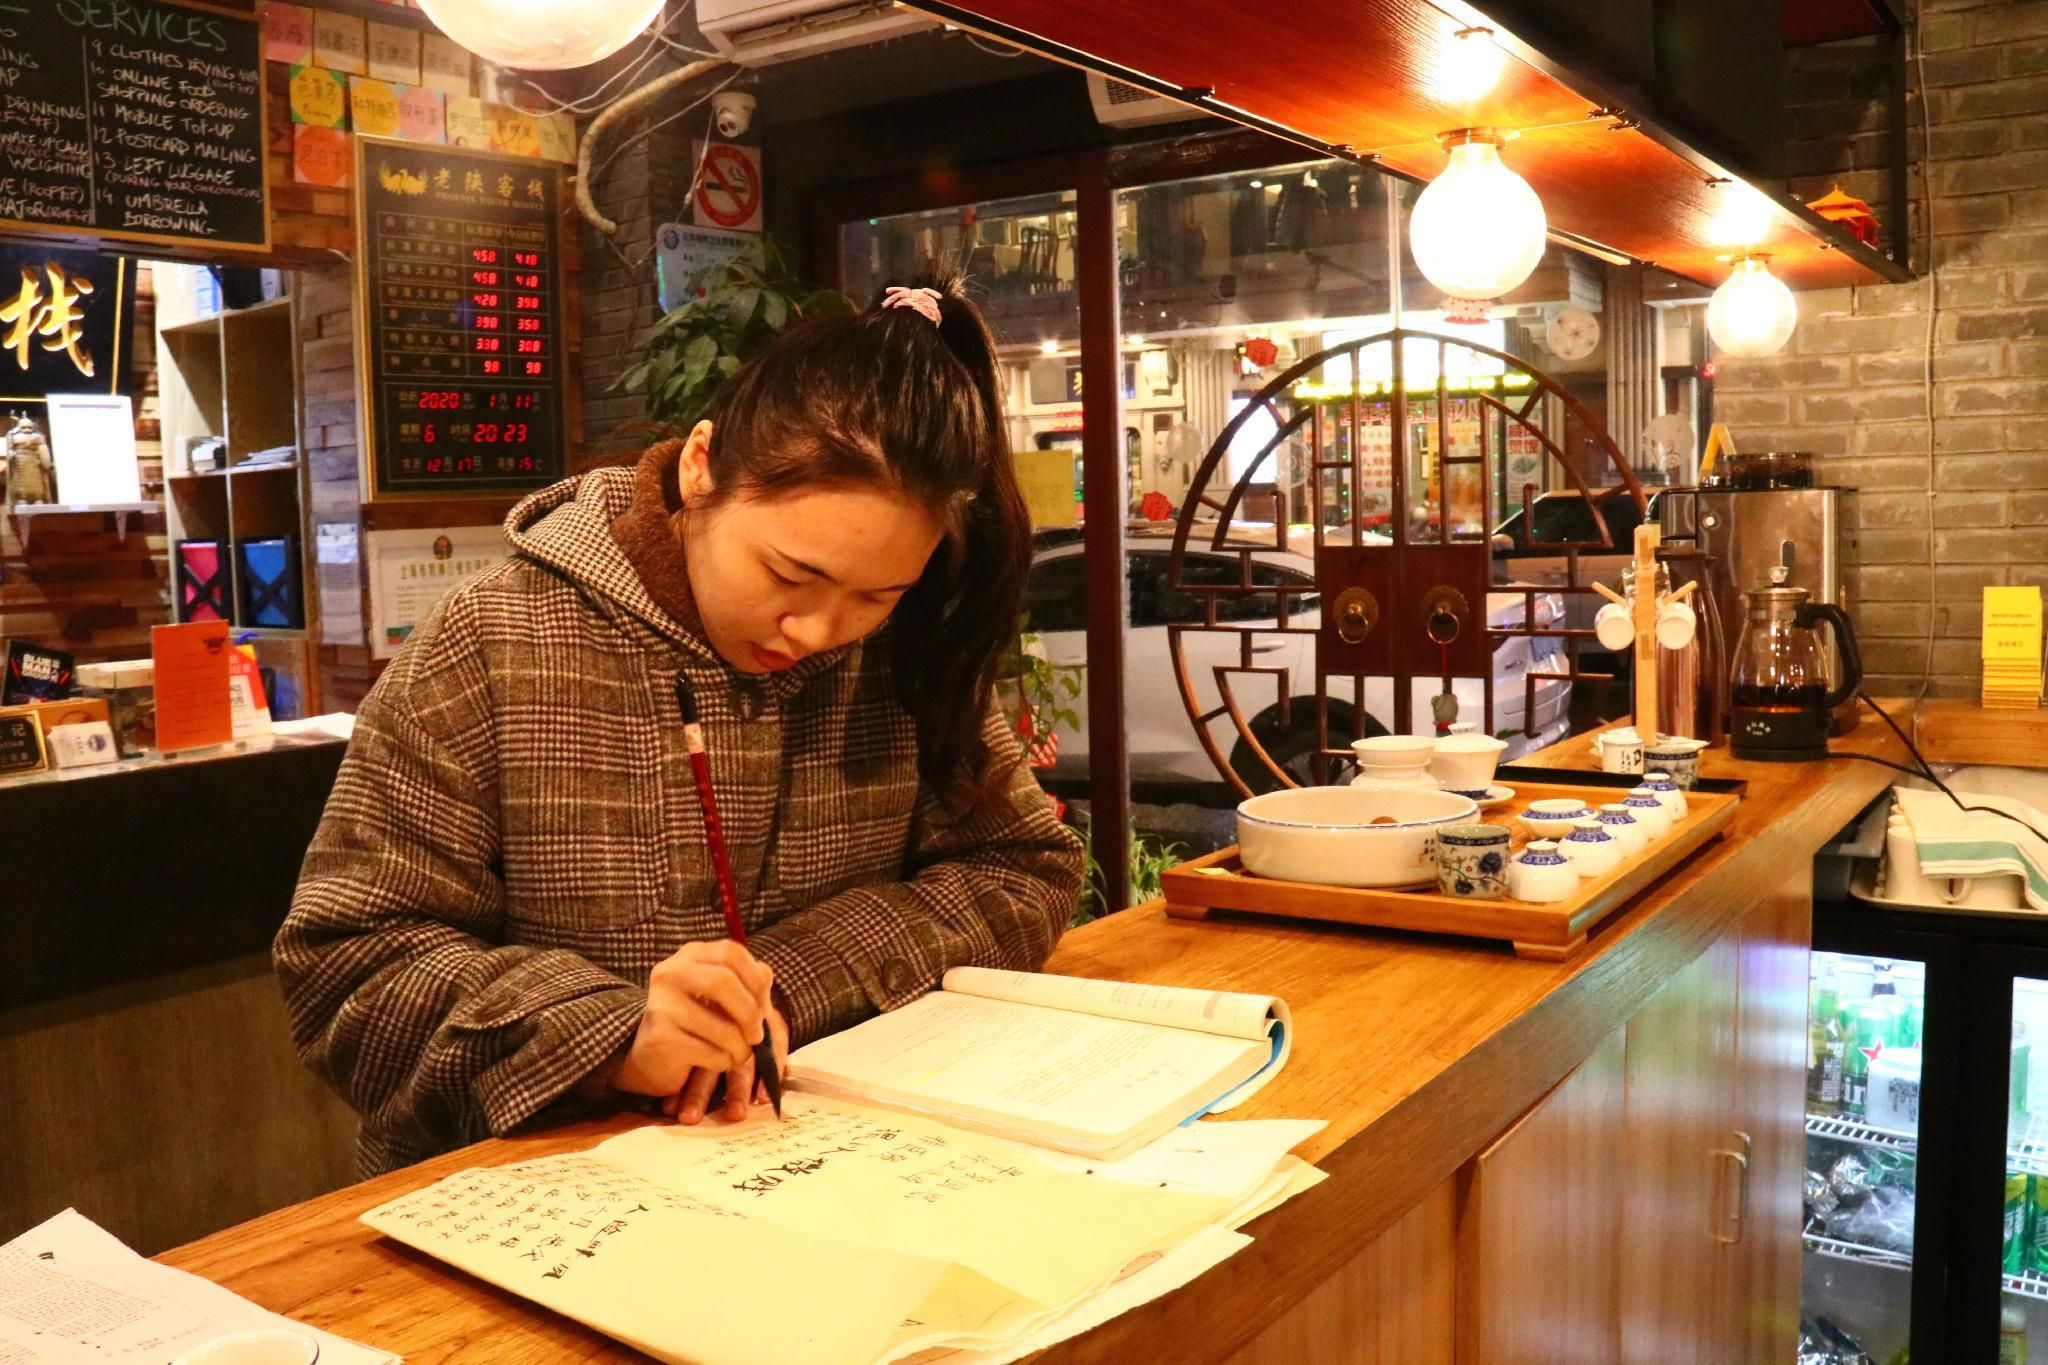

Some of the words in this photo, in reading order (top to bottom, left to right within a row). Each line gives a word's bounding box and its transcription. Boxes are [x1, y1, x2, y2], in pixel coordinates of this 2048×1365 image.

[56, 0, 226, 51] SERVICES
[110, 44, 184, 68] CLOTHES
[113, 69, 172, 91] ONLINE
[179, 80, 216, 98] FOOD
[5, 95, 87, 119] DRINKING
[97, 82, 177, 108] SHOPPING
[180, 100, 250, 120] ORDERING
[114, 104, 175, 130] MOBILE
[93, 125, 113, 144] 12
[116, 128, 189, 156] POSTCARD
[195, 142, 258, 165] MAILING
[124, 155, 166, 175] LEFT
[169, 163, 235, 186] LUGGAGE
[126, 193, 209, 216] UMBRELLA
[123, 211, 217, 235] BORROWING
[0, 262, 94, 378] 栈
[418, 391, 460, 409] 2020
[489, 394, 497, 409] 1
[515, 394, 532, 409] 11
[423, 423, 437, 444] 6
[473, 423, 498, 444] 20
[503, 423, 529, 444] 23
[426, 457, 443, 473] 12
[457, 457, 474, 473] 17
